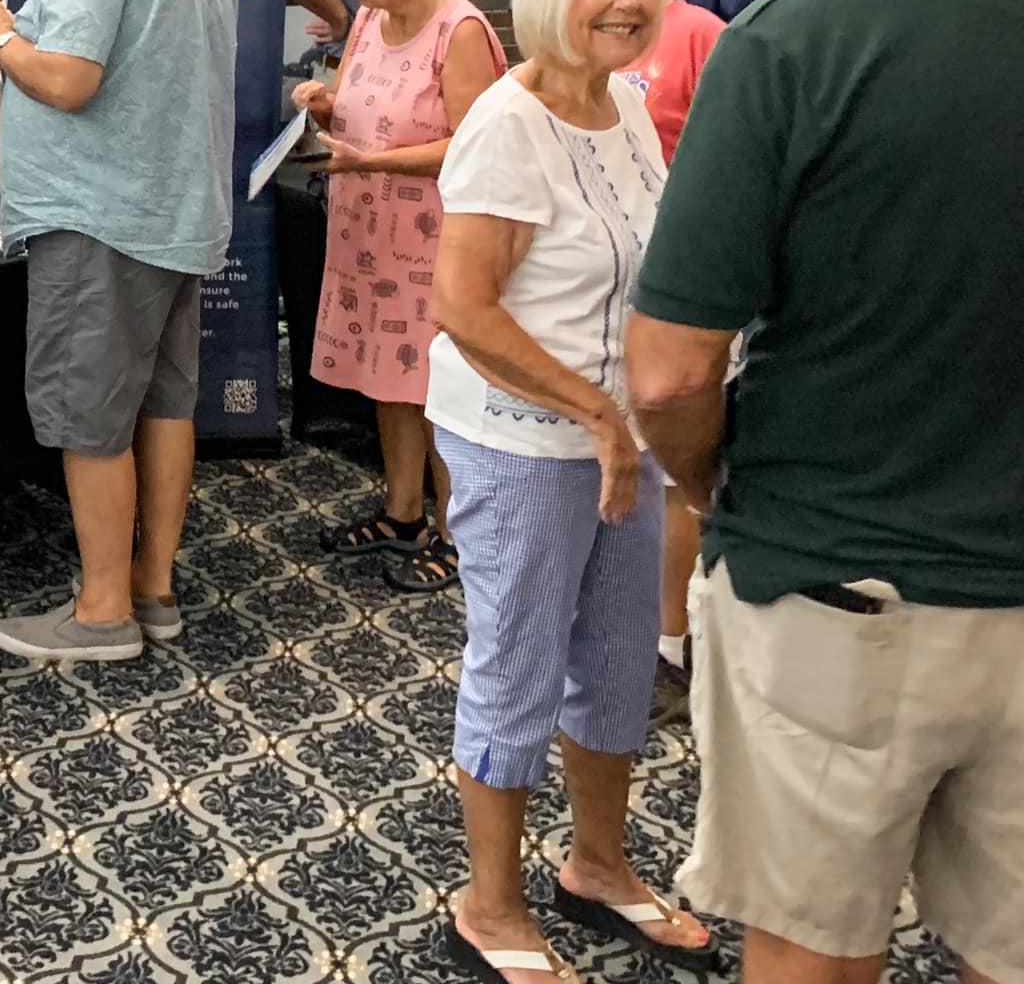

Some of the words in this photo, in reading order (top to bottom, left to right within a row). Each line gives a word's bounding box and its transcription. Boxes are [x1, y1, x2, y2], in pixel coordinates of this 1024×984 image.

[228, 272, 248, 282] the
[199, 287, 230, 295] nsure
[216, 299, 240, 310] safe
